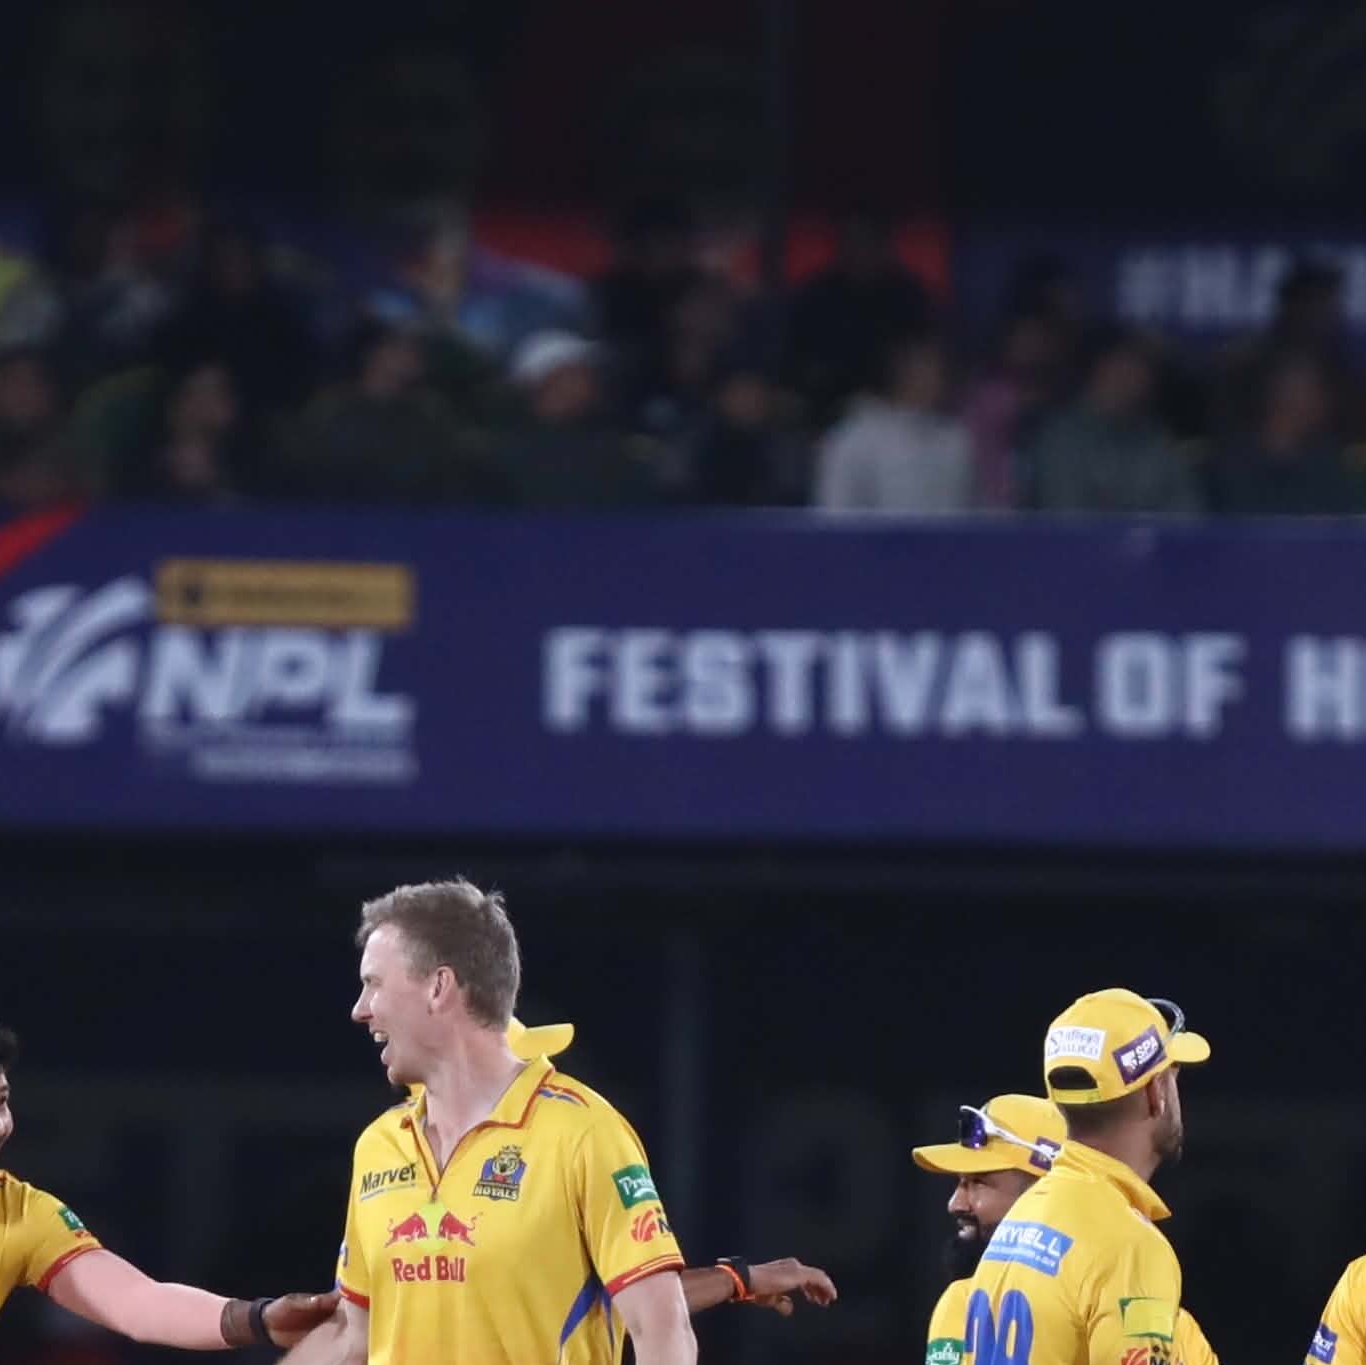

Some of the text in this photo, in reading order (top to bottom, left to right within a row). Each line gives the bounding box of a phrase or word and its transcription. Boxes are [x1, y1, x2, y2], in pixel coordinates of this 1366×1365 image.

[140, 626, 415, 722] NPL
[542, 627, 1085, 738] FESTIVAL
[1091, 631, 1245, 741] OF
[393, 1256, 431, 1283] Red
